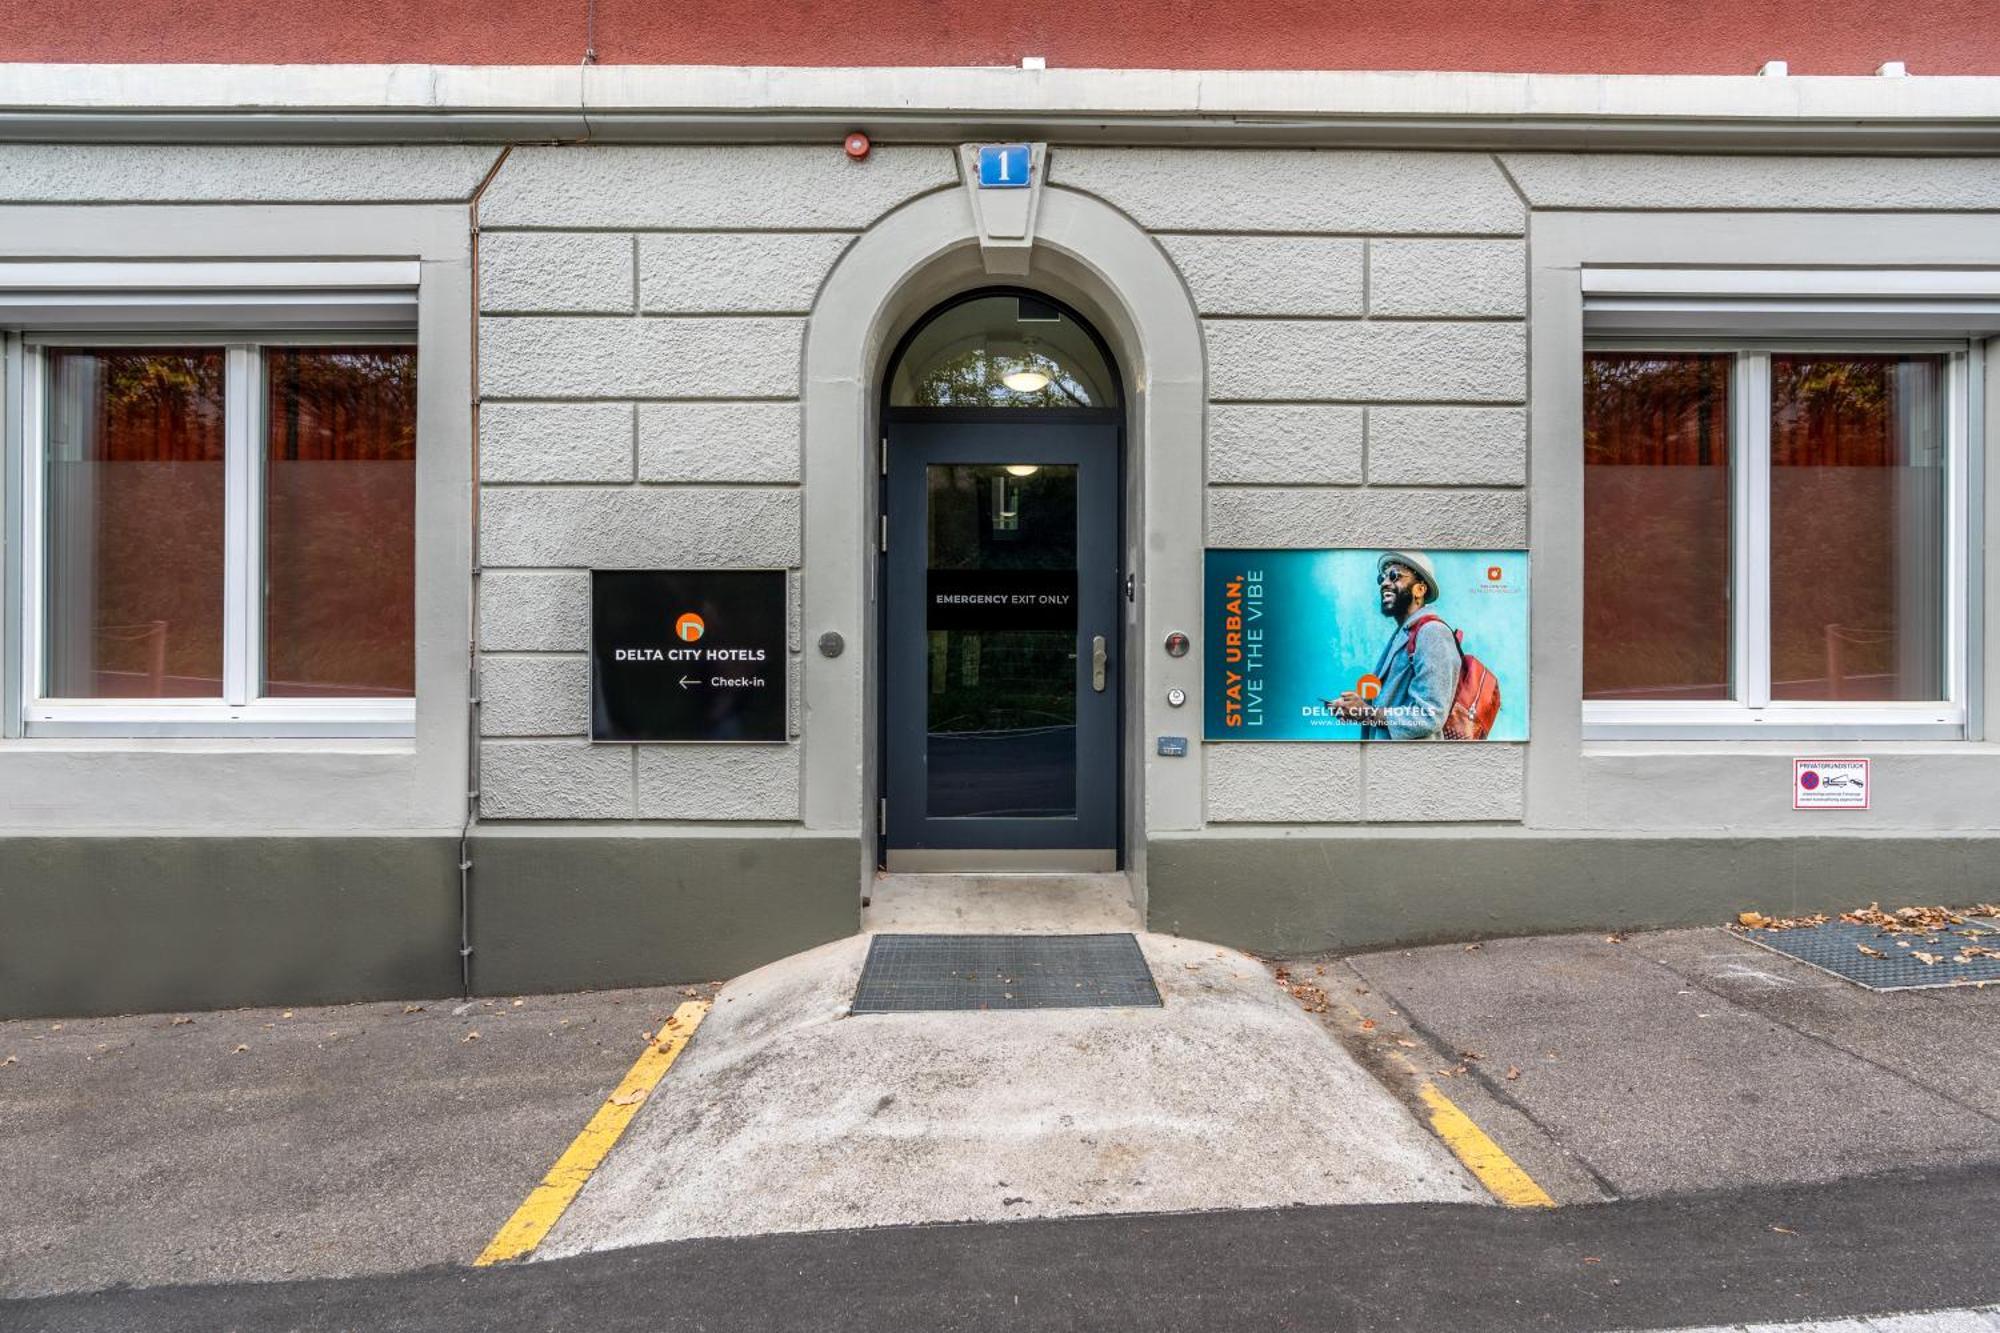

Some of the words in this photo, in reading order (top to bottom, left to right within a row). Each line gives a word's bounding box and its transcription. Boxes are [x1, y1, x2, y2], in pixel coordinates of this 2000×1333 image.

[998, 150, 1011, 181] 1
[936, 595, 1008, 604] EMERGENCY
[1011, 595, 1036, 604] EXIT
[1038, 595, 1069, 604] ONLY
[1247, 570, 1263, 621] VIBE
[1226, 575, 1245, 662] URBAN,
[615, 649, 664, 661] DELTA
[668, 649, 701, 661] CITY
[706, 649, 766, 661] HOTELS
[1247, 629, 1263, 672] THE
[711, 677, 765, 688] Check-in
[1226, 671, 1242, 727] STAY
[1247, 679, 1263, 725] LIVE
[1302, 706, 1345, 717] DELTA
[1349, 706, 1378, 717] CITY
[1383, 706, 1436, 717] HOTELS
